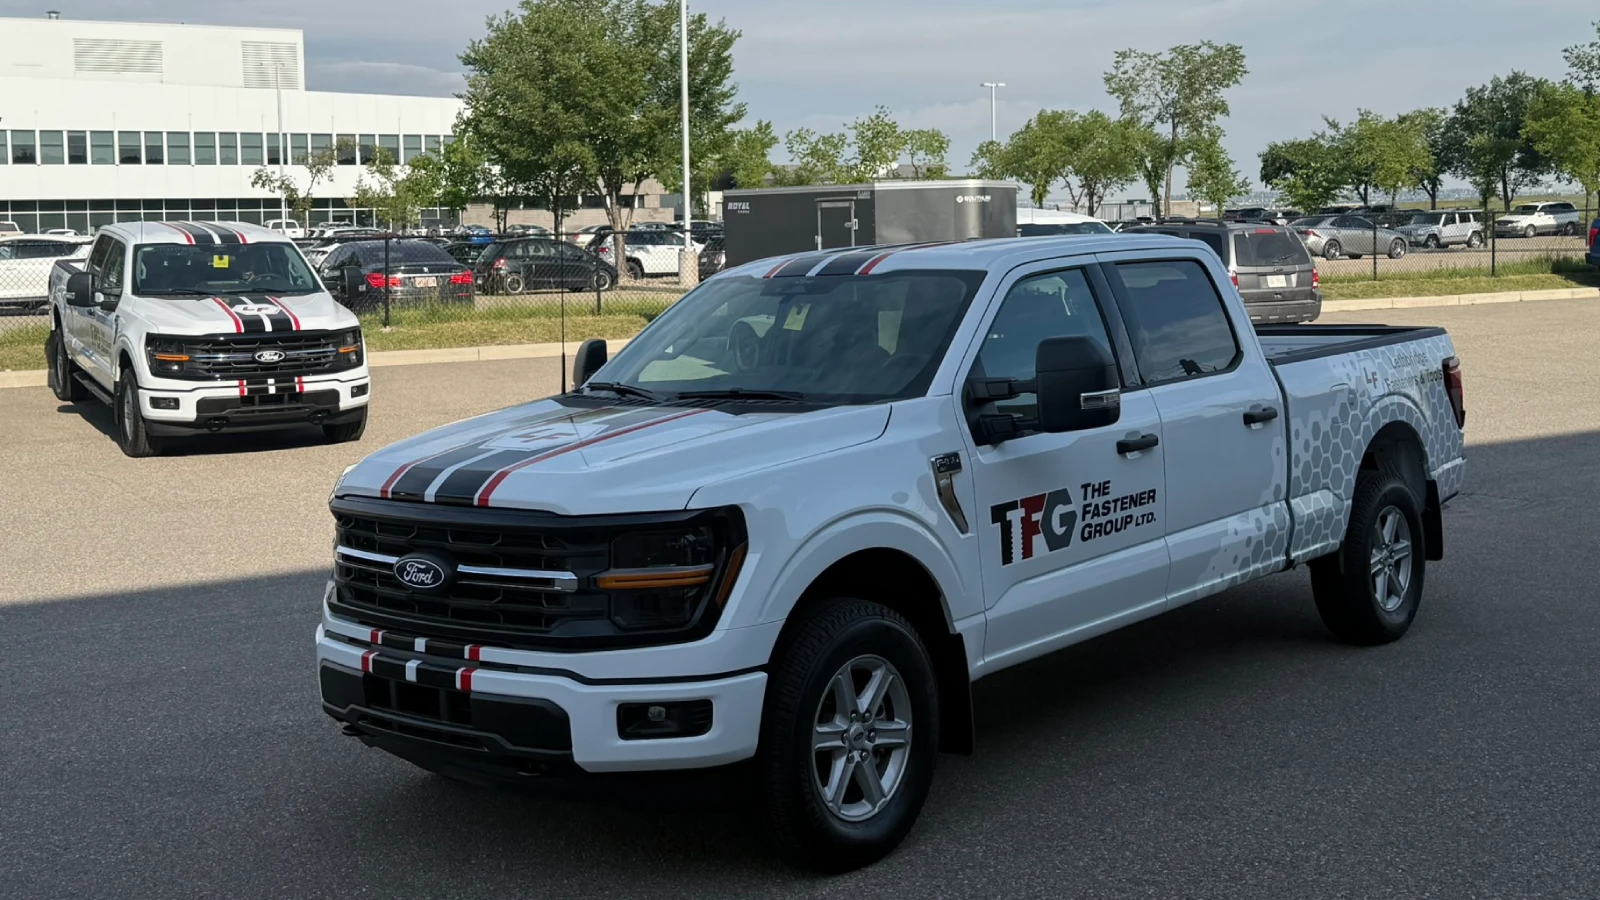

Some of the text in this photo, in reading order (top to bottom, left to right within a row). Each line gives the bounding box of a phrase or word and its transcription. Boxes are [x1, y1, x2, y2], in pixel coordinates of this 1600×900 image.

[727, 201, 750, 210] ROYAL
[1388, 352, 1429, 369] Lethbridge
[1363, 367, 1378, 389] LF
[1384, 368, 1443, 391] Fasteners & Tools
[1081, 479, 1111, 501] THE
[1081, 488, 1156, 522] FASTENER
[990, 488, 1078, 566] TFG
[1080, 512, 1156, 542] GROUP LTD.
[403, 562, 434, 584] Ford
